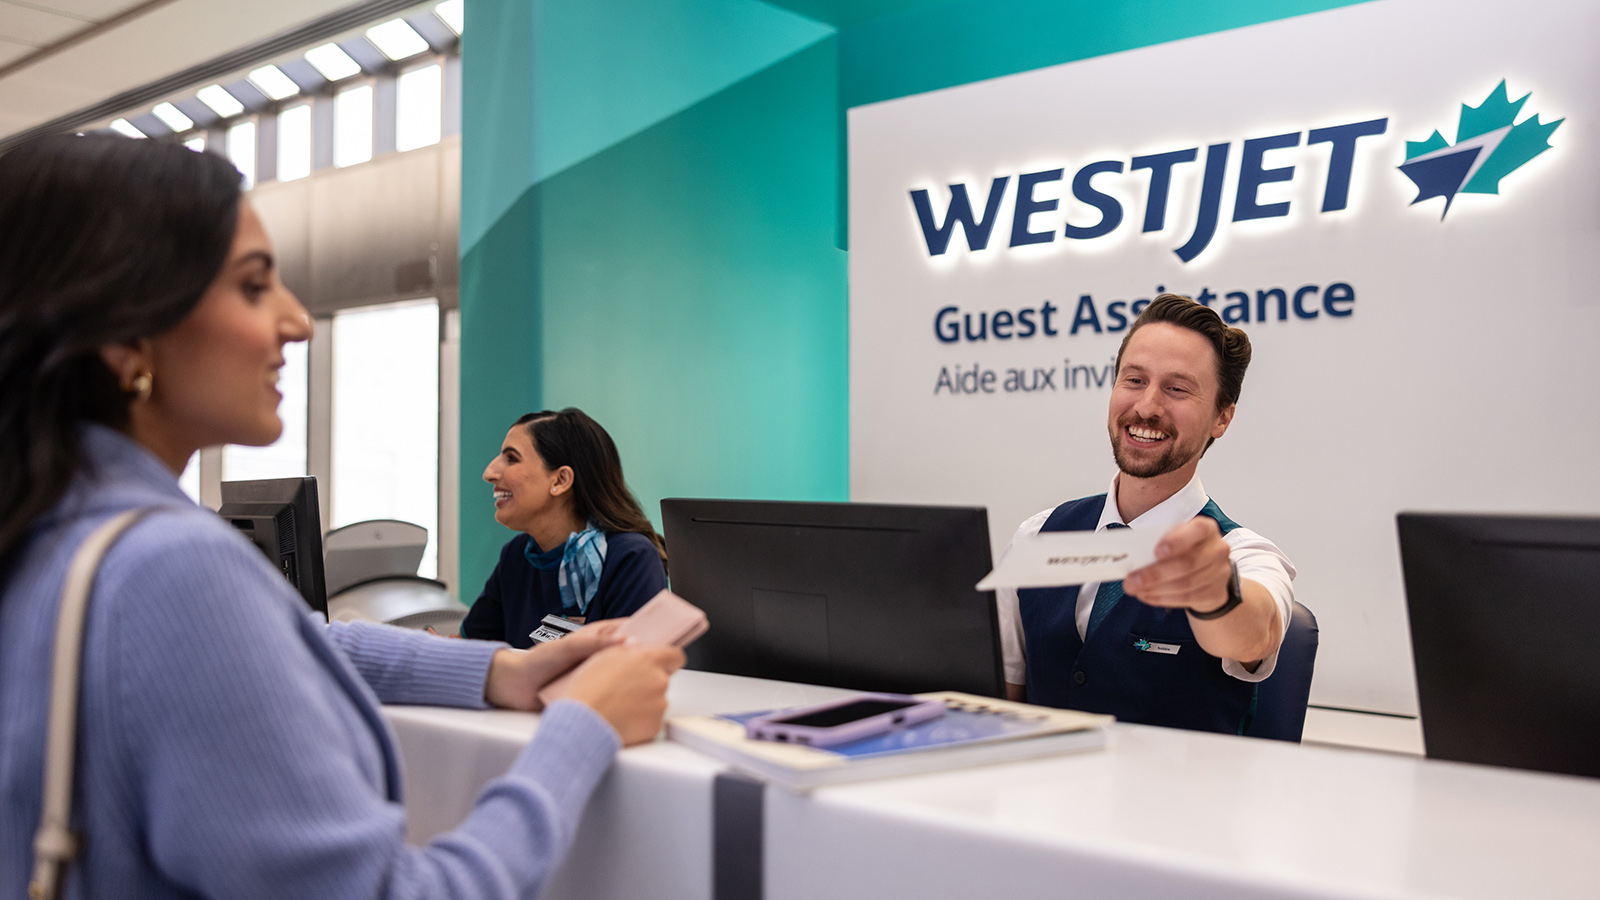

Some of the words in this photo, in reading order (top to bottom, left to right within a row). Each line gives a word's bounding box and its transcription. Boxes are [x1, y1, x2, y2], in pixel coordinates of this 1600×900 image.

[909, 118, 1388, 263] WESTJET
[934, 301, 1058, 344] Guest
[1070, 282, 1355, 335] Astance
[934, 363, 997, 395] Aide
[1003, 368, 1056, 392] aux
[1064, 356, 1115, 390] invi
